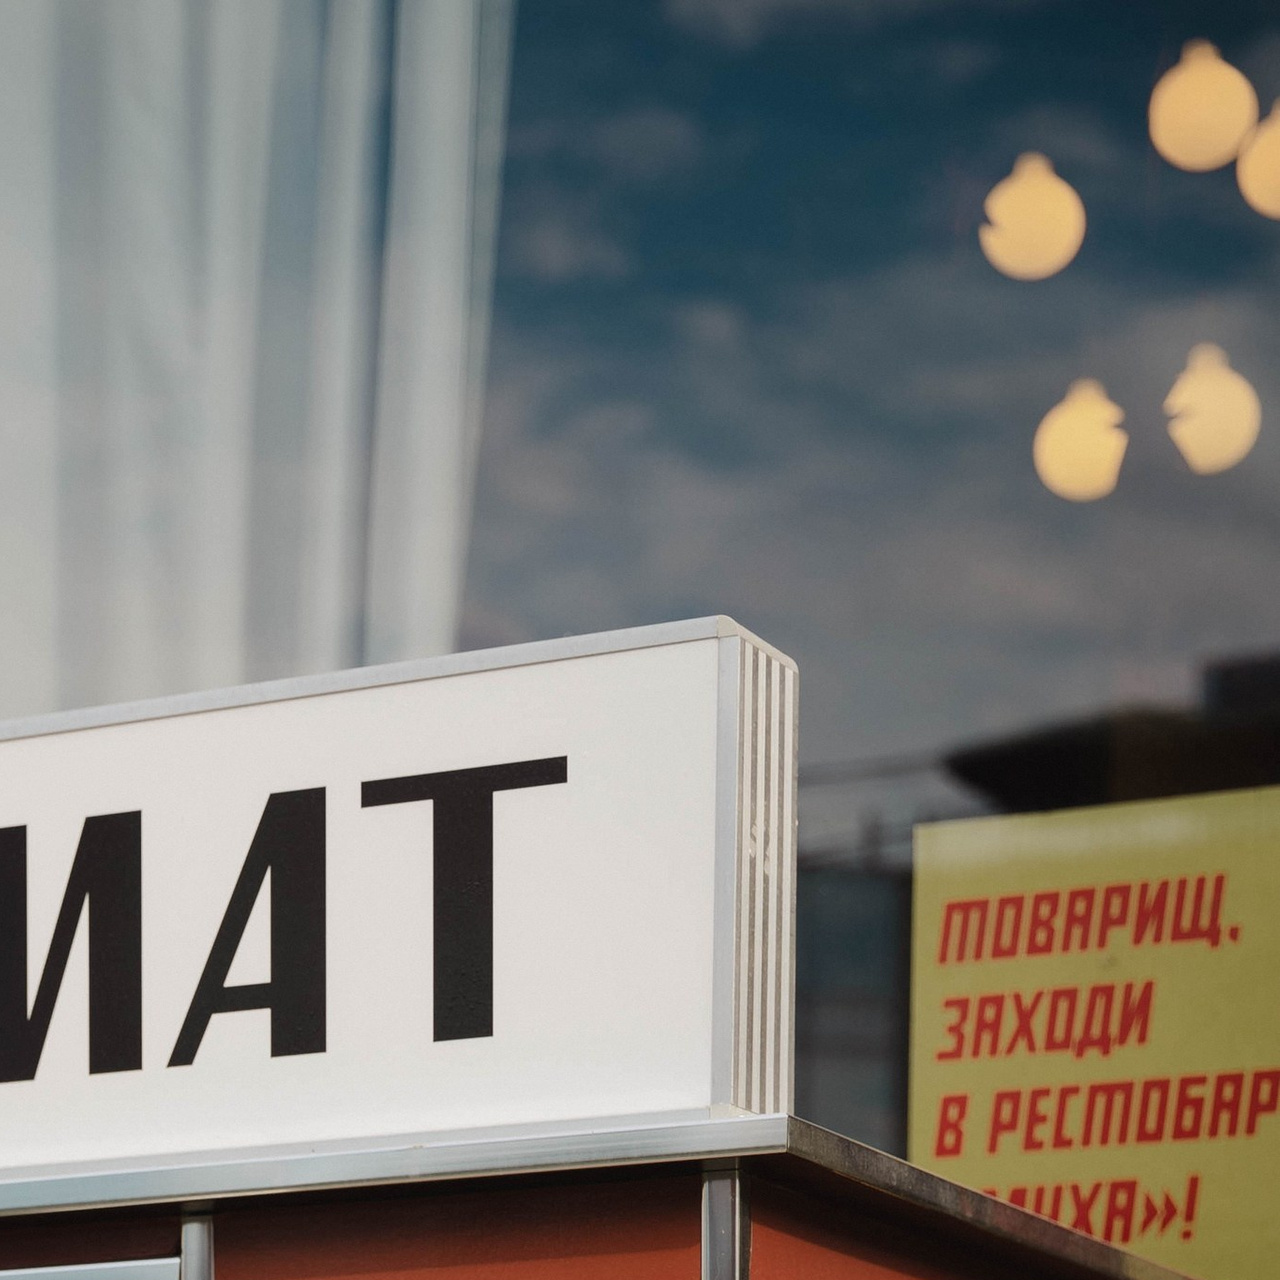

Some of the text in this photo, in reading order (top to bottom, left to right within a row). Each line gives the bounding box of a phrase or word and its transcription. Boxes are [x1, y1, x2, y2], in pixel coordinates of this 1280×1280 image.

[935, 979, 1156, 1062] ЗАХОДИ
[933, 1068, 1280, 1158] В РЕСТОБАР
